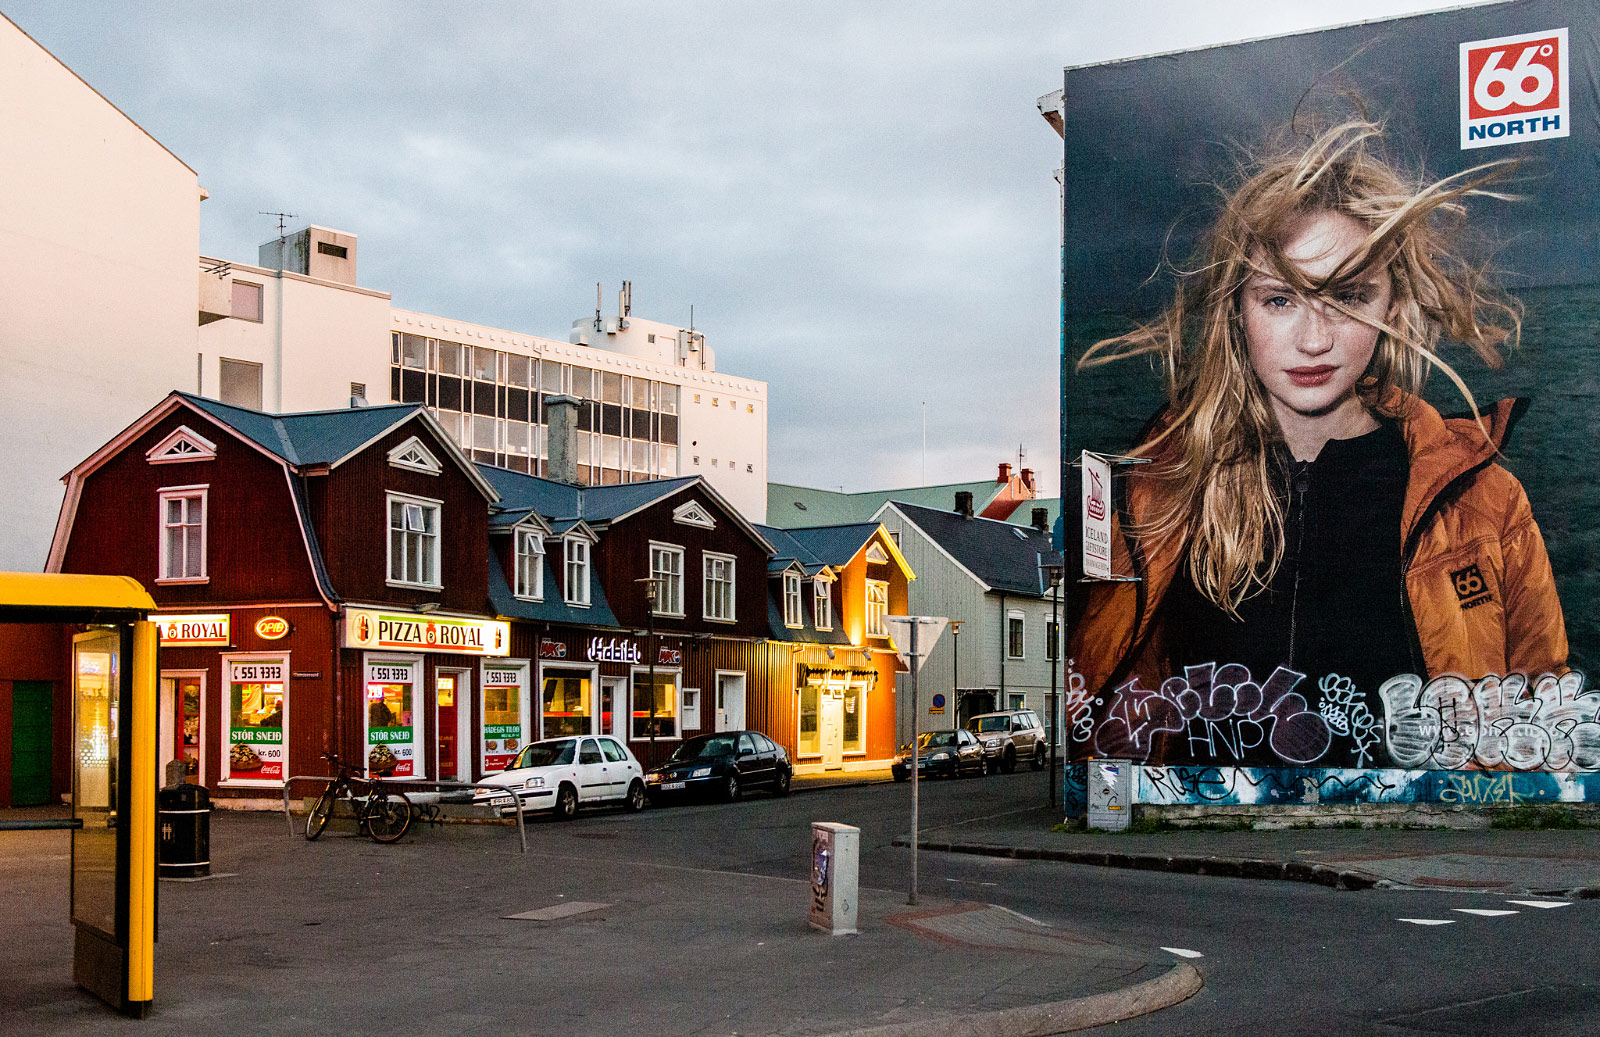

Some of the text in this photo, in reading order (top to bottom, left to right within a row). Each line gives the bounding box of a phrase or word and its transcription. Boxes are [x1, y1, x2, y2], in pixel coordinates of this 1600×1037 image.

[1474, 44, 1553, 111] 66°
[1469, 115, 1560, 140] NORTH
[1085, 526, 1108, 544] ICELAND
[1461, 594, 1493, 611] NORTH
[182, 623, 226, 638] ROYAL
[379, 621, 421, 642] PIZZA
[441, 626, 484, 646] ROYAL
[241, 667, 257, 679] 551
[260, 667, 281, 679] 7373
[377, 667, 408, 680] 551 7373
[491, 672, 517, 683] 551 7373
[231, 729, 254, 741] STÓR
[268, 750, 281, 758] 600
[402, 748, 413, 756] 600
